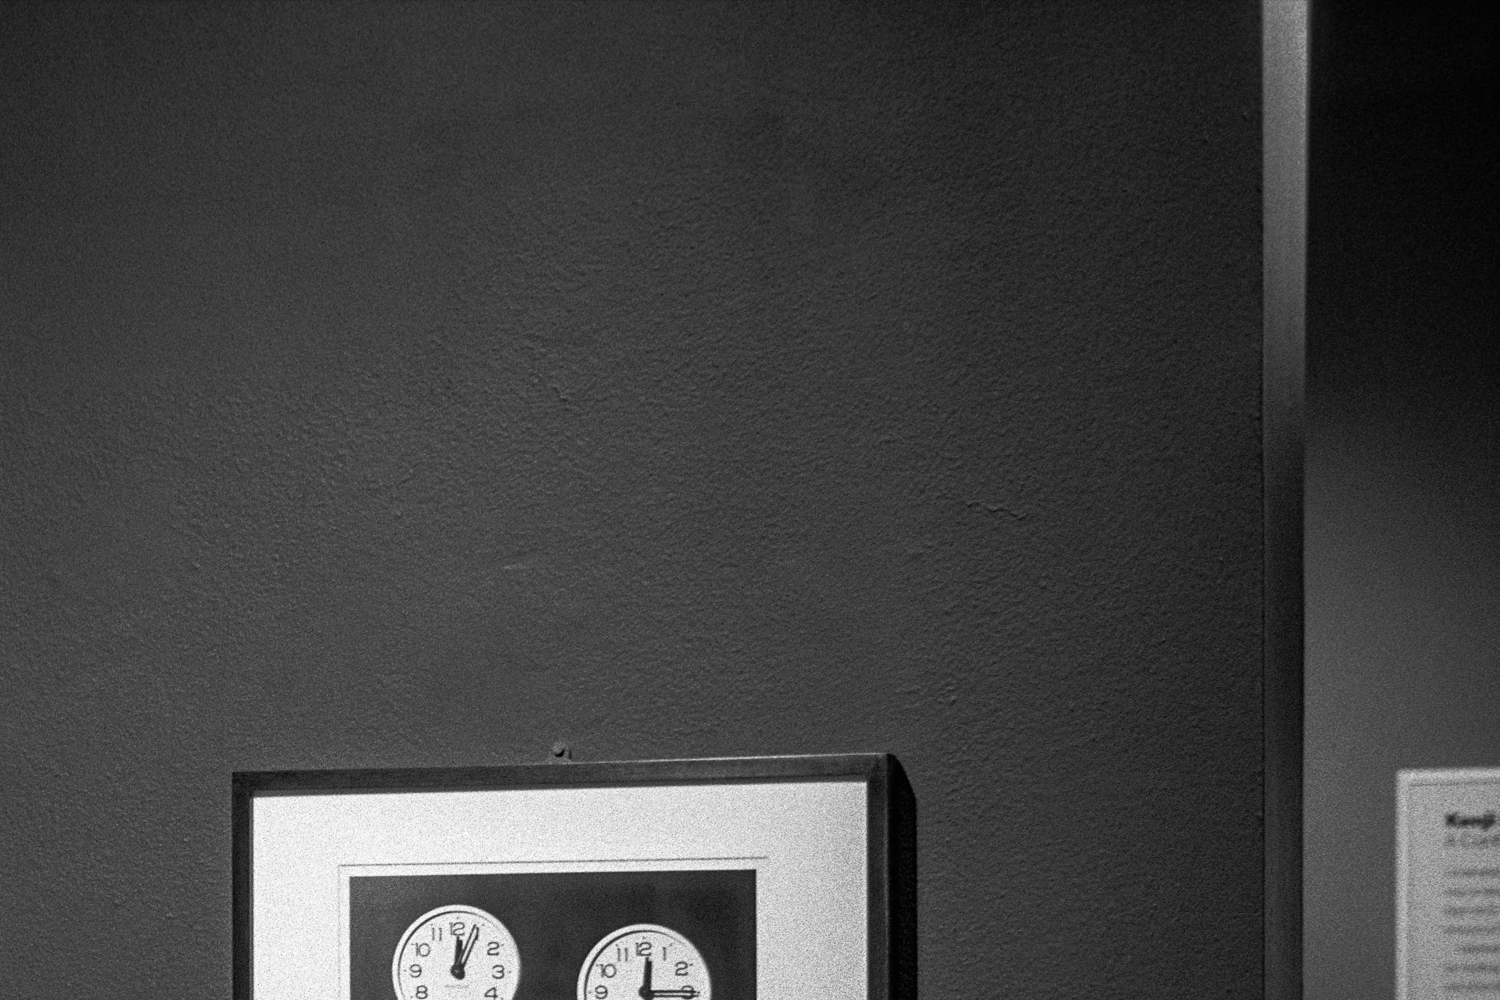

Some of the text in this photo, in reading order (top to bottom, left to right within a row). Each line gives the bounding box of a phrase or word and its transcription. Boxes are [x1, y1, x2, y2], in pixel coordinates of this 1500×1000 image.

[432, 927, 442, 941] 11
[449, 922, 465, 936] 12
[416, 943, 431, 957] 10
[487, 941, 500, 956] 2
[617, 948, 628, 962] 11
[635, 942, 652, 957] 12
[663, 947, 666, 961] 1
[410, 964, 422, 978] 9
[492, 965, 505, 979] 3
[600, 964, 617, 978] 10
[675, 962, 688, 976] 2
[416, 985, 428, 999] 8
[484, 987, 498, 1000] 4
[595, 985, 608, 1000] 9
